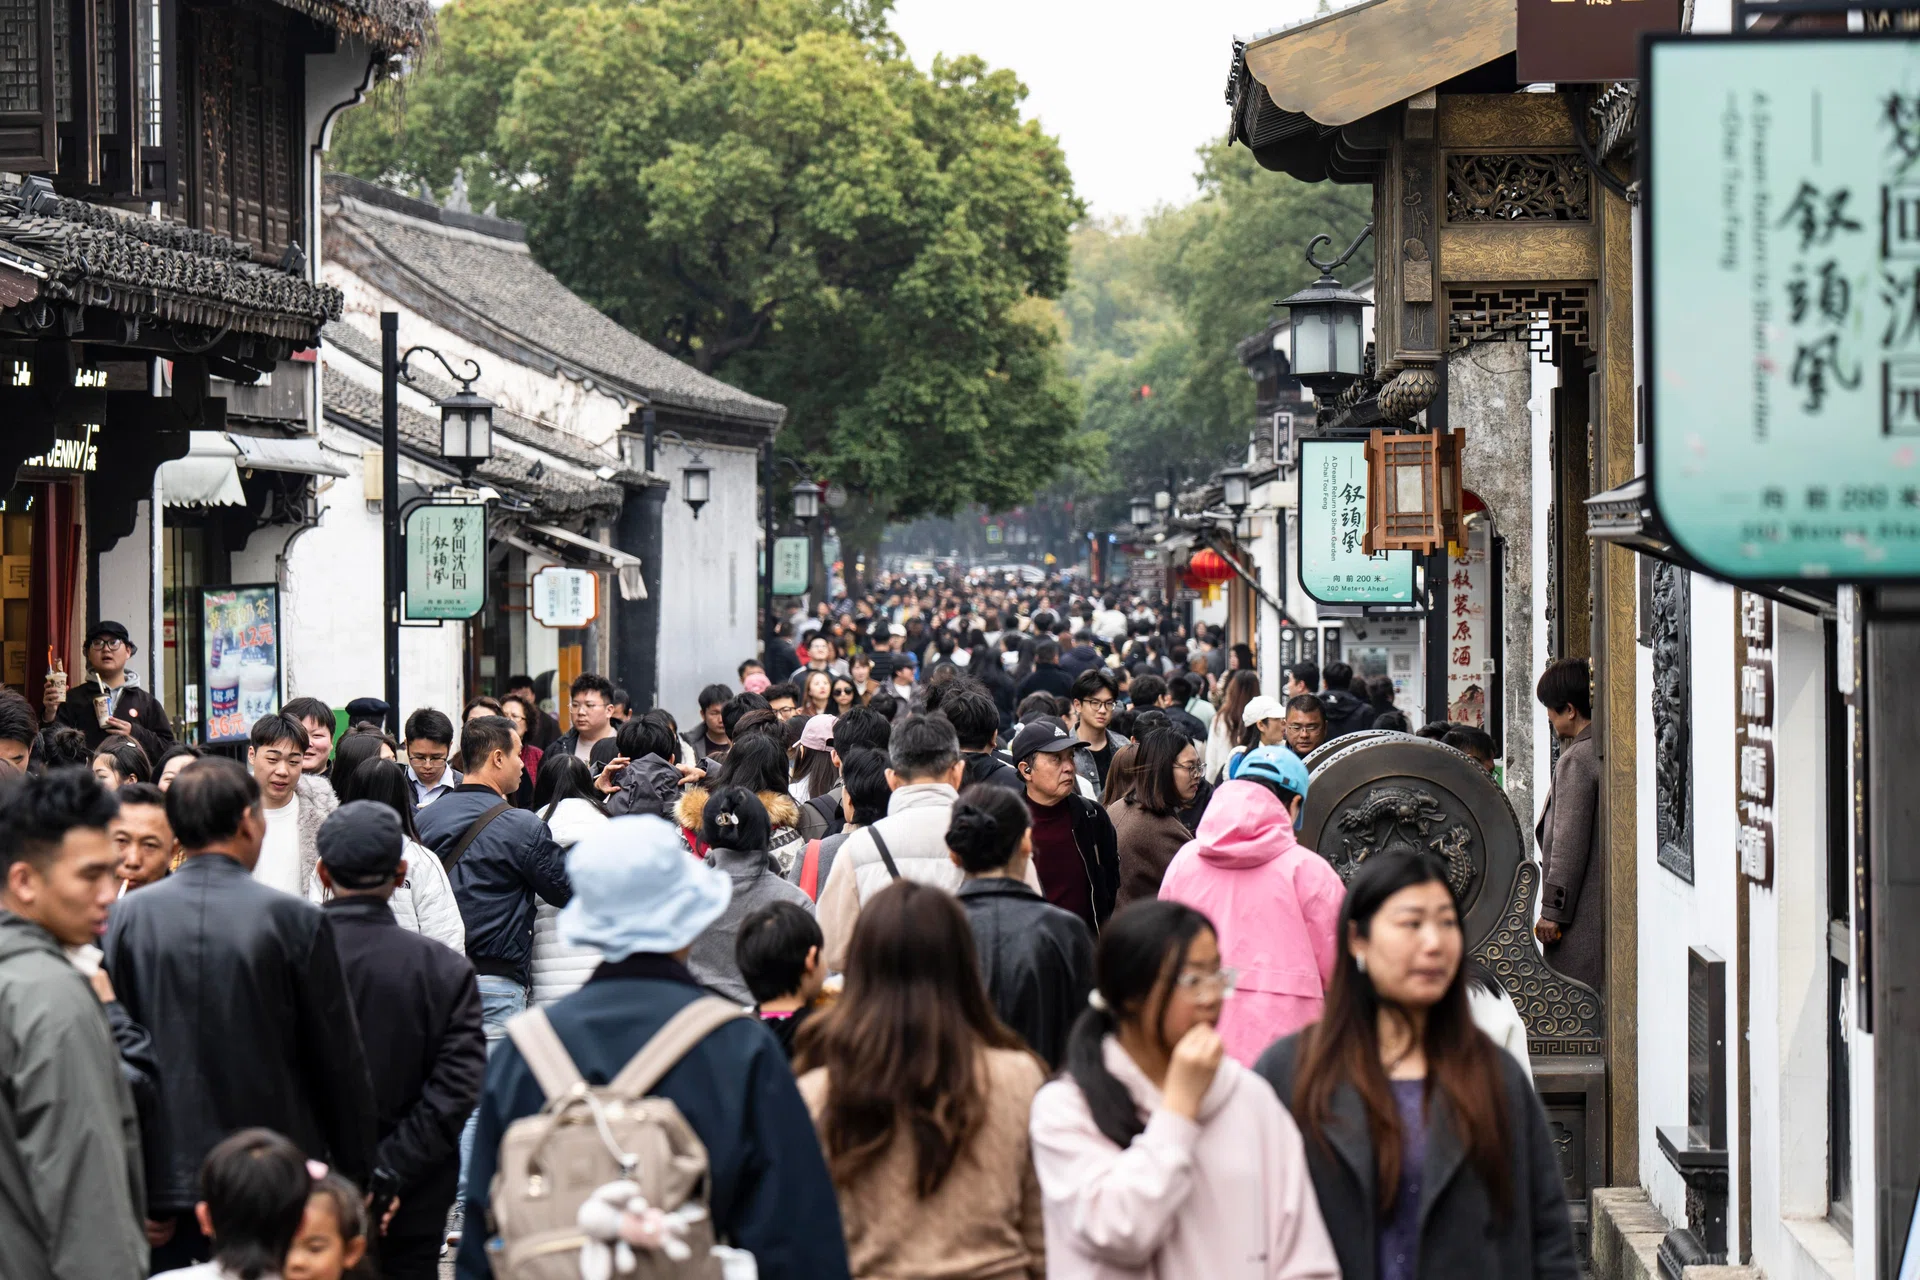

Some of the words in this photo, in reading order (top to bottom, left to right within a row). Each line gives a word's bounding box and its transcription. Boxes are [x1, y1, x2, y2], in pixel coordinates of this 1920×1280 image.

[1321, 493, 1329, 510] Feng
[452, 517, 466, 590] 梦回沈园
[208, 598, 270, 631] 黄酒奶茶
[239, 623, 274, 648] 12元
[209, 713, 246, 739] 16元
